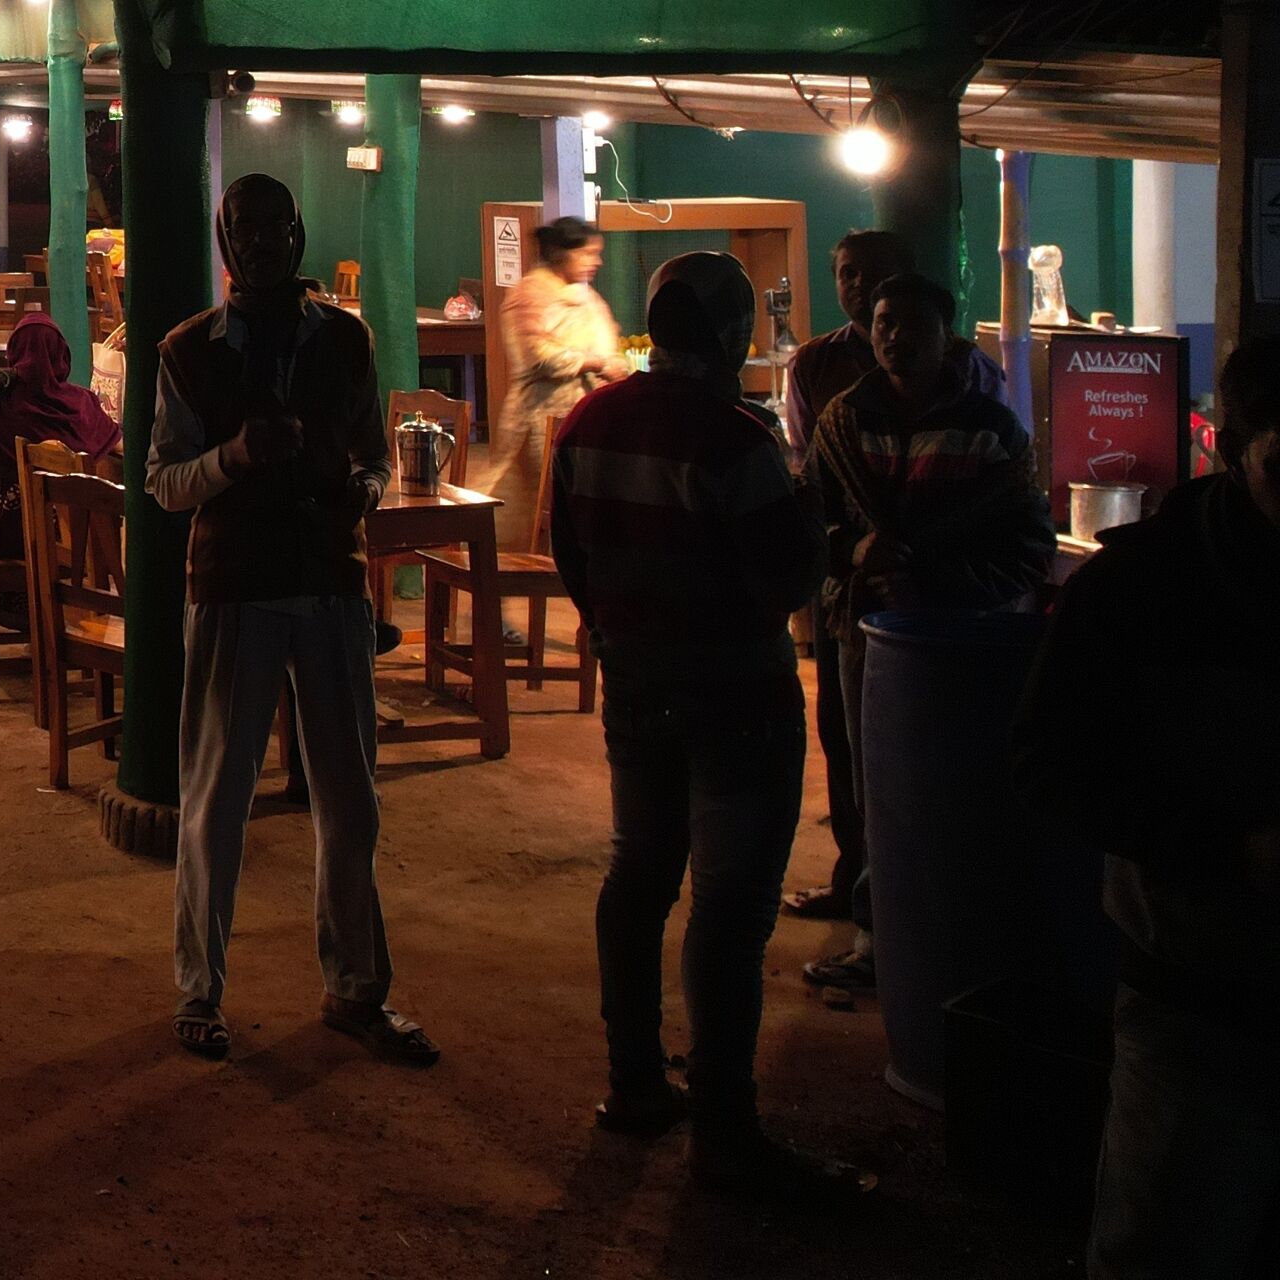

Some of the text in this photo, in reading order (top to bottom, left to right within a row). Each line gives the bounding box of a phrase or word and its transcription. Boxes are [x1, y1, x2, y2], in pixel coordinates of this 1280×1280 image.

[1066, 350, 1163, 375] AMAZON
[1084, 389, 1149, 404] Refreshes
[1089, 404, 1135, 419] Always
